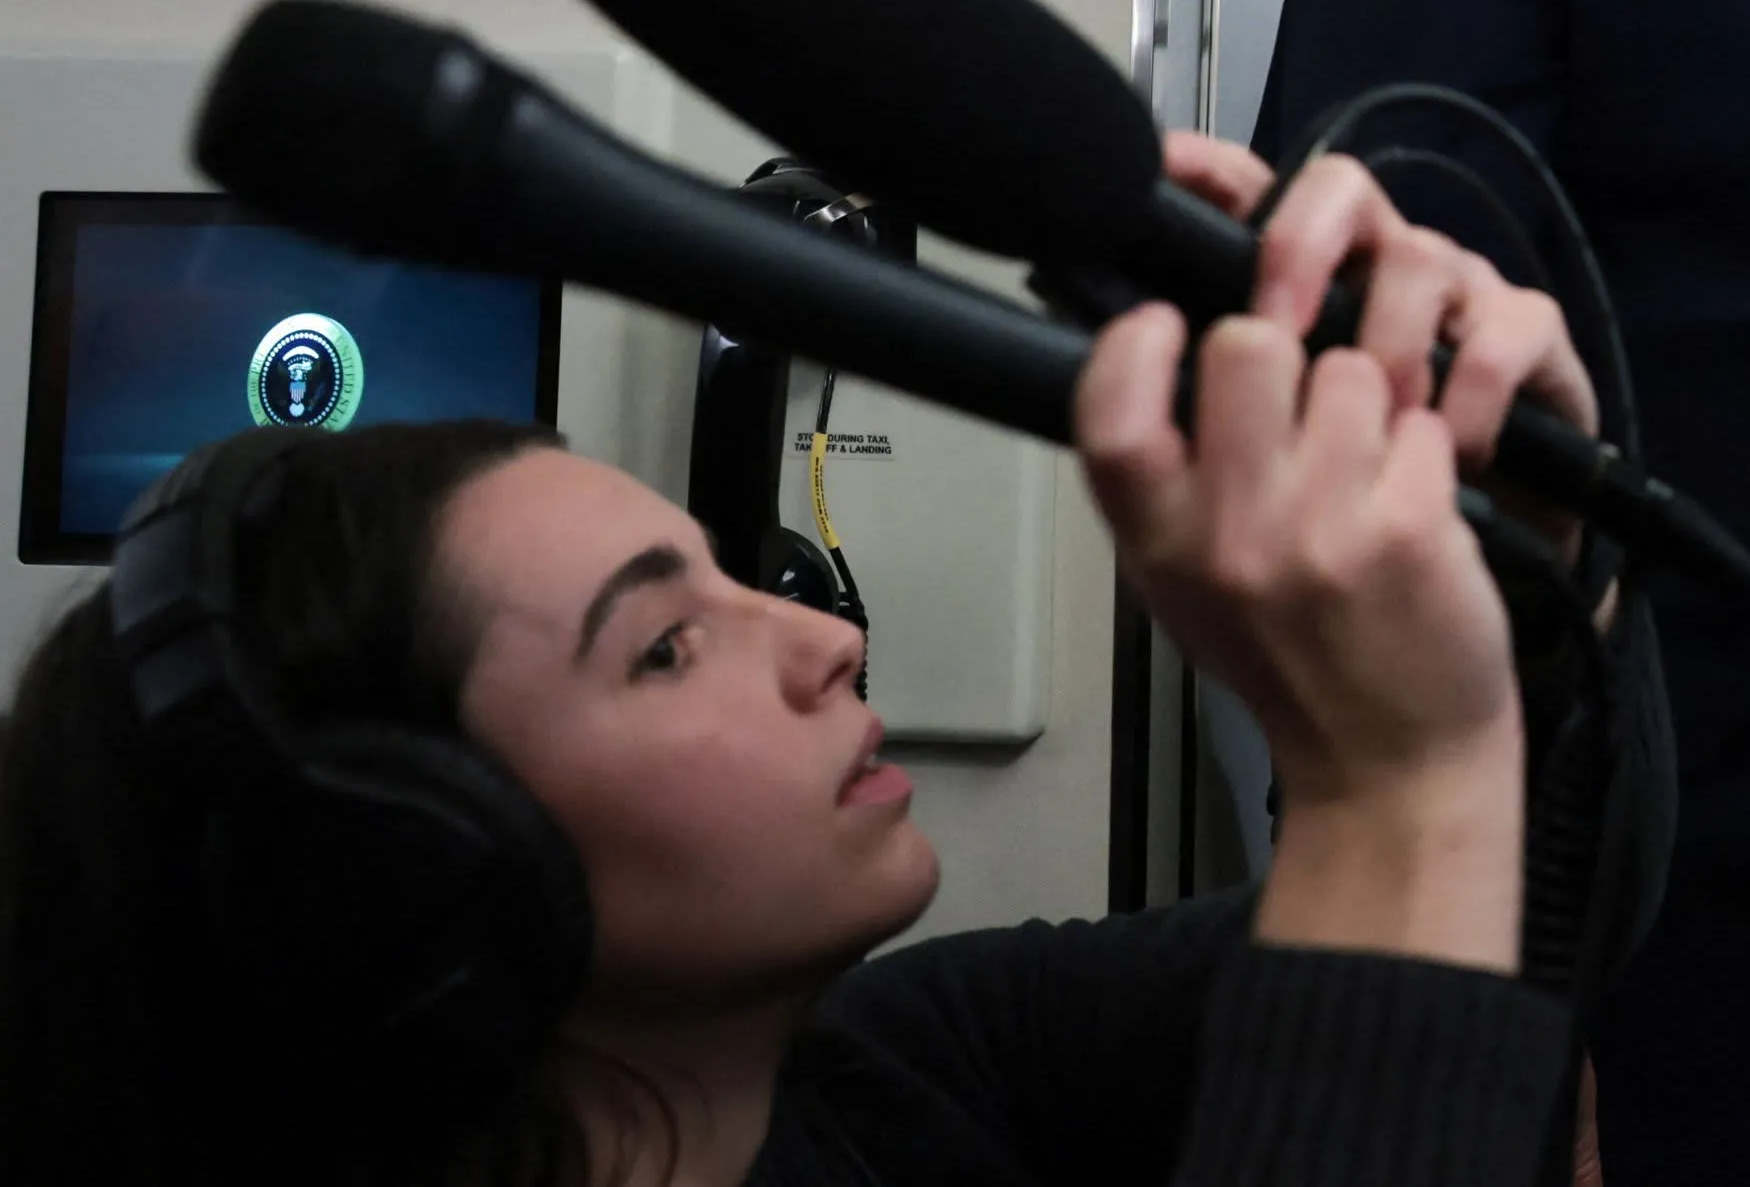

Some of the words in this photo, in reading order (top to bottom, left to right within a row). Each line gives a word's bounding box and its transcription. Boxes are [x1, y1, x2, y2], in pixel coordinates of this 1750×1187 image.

[827, 433, 864, 444] DURING
[795, 442, 837, 453] TAKFF
[839, 444, 846, 453] &
[849, 445, 892, 454] LANDING
